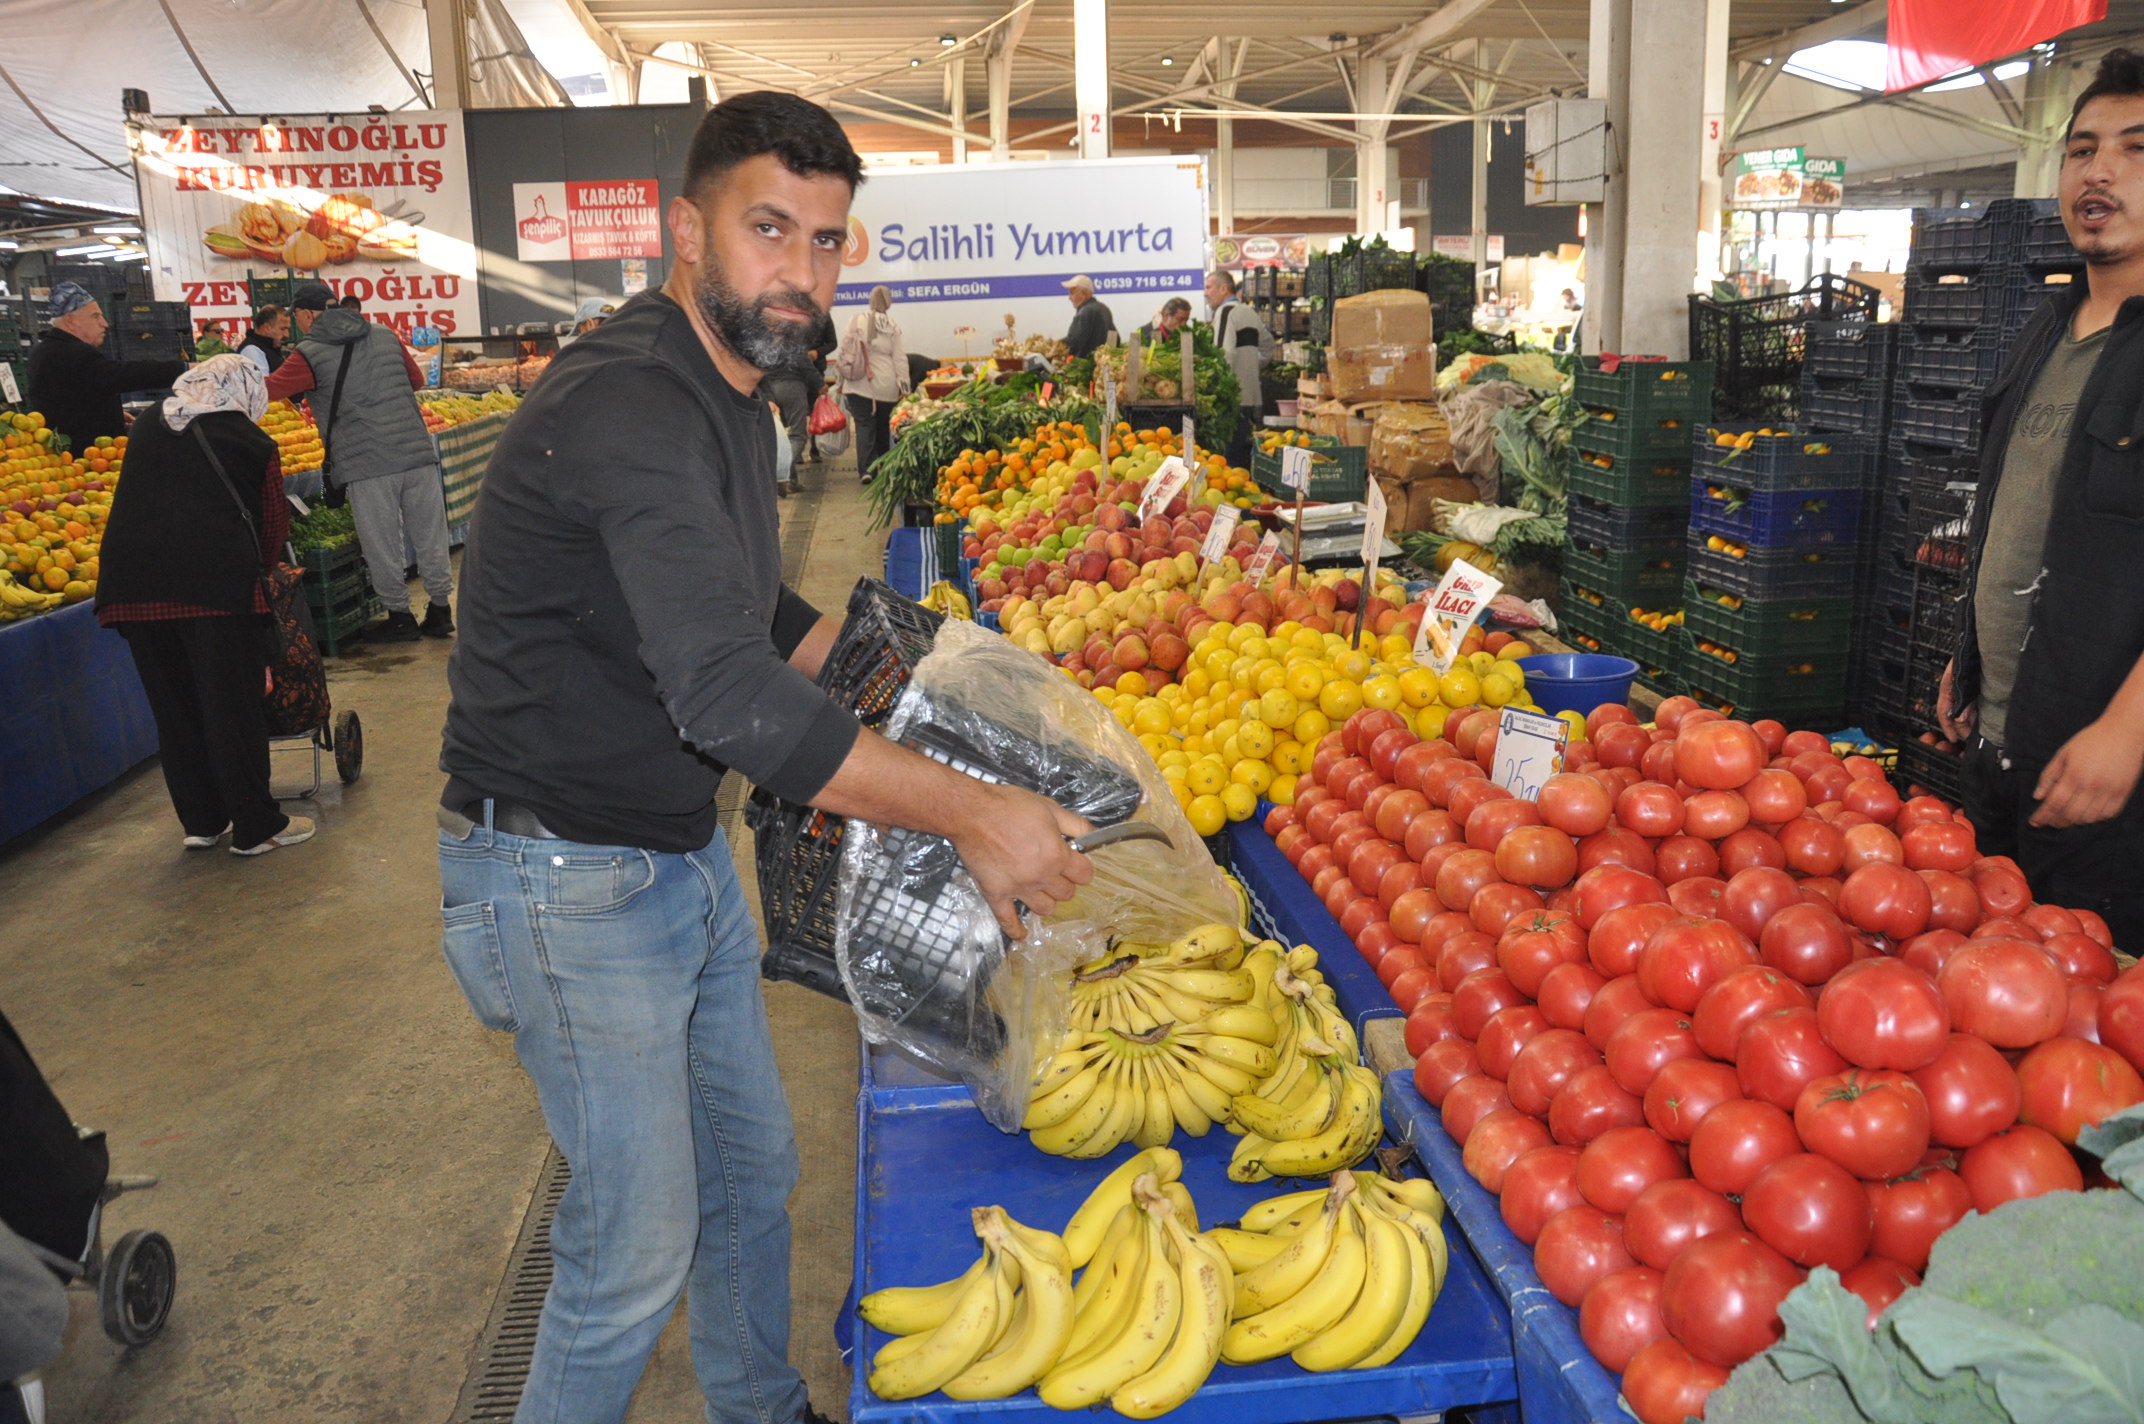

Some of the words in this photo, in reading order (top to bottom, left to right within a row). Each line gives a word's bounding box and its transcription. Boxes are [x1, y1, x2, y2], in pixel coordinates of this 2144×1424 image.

[161, 116, 448, 153] ZEYTİNOĞLU
[1091, 113, 1101, 133] 2
[1709, 121, 1719, 141] 3
[1773, 147, 1798, 164] GIDA
[1805, 160, 1838, 173] GIDA
[175, 153, 443, 193] KURUYEMİŞ
[579, 182, 646, 206] KARAGÖZ
[523, 217, 562, 240] şenpiliç
[569, 206, 658, 230] TAVUKÇULUK
[879, 222, 995, 262] Salihli
[1007, 222, 1174, 261] Yumurta
[907, 284, 941, 298] SEFA
[943, 281, 990, 297] ERGÜN
[1103, 276, 1133, 289] 0539
[1135, 275, 1157, 288] 718
[1159, 274, 1175, 287] 62
[1177, 274, 1192, 286] 48
[1434, 586, 1477, 615] İLACI
